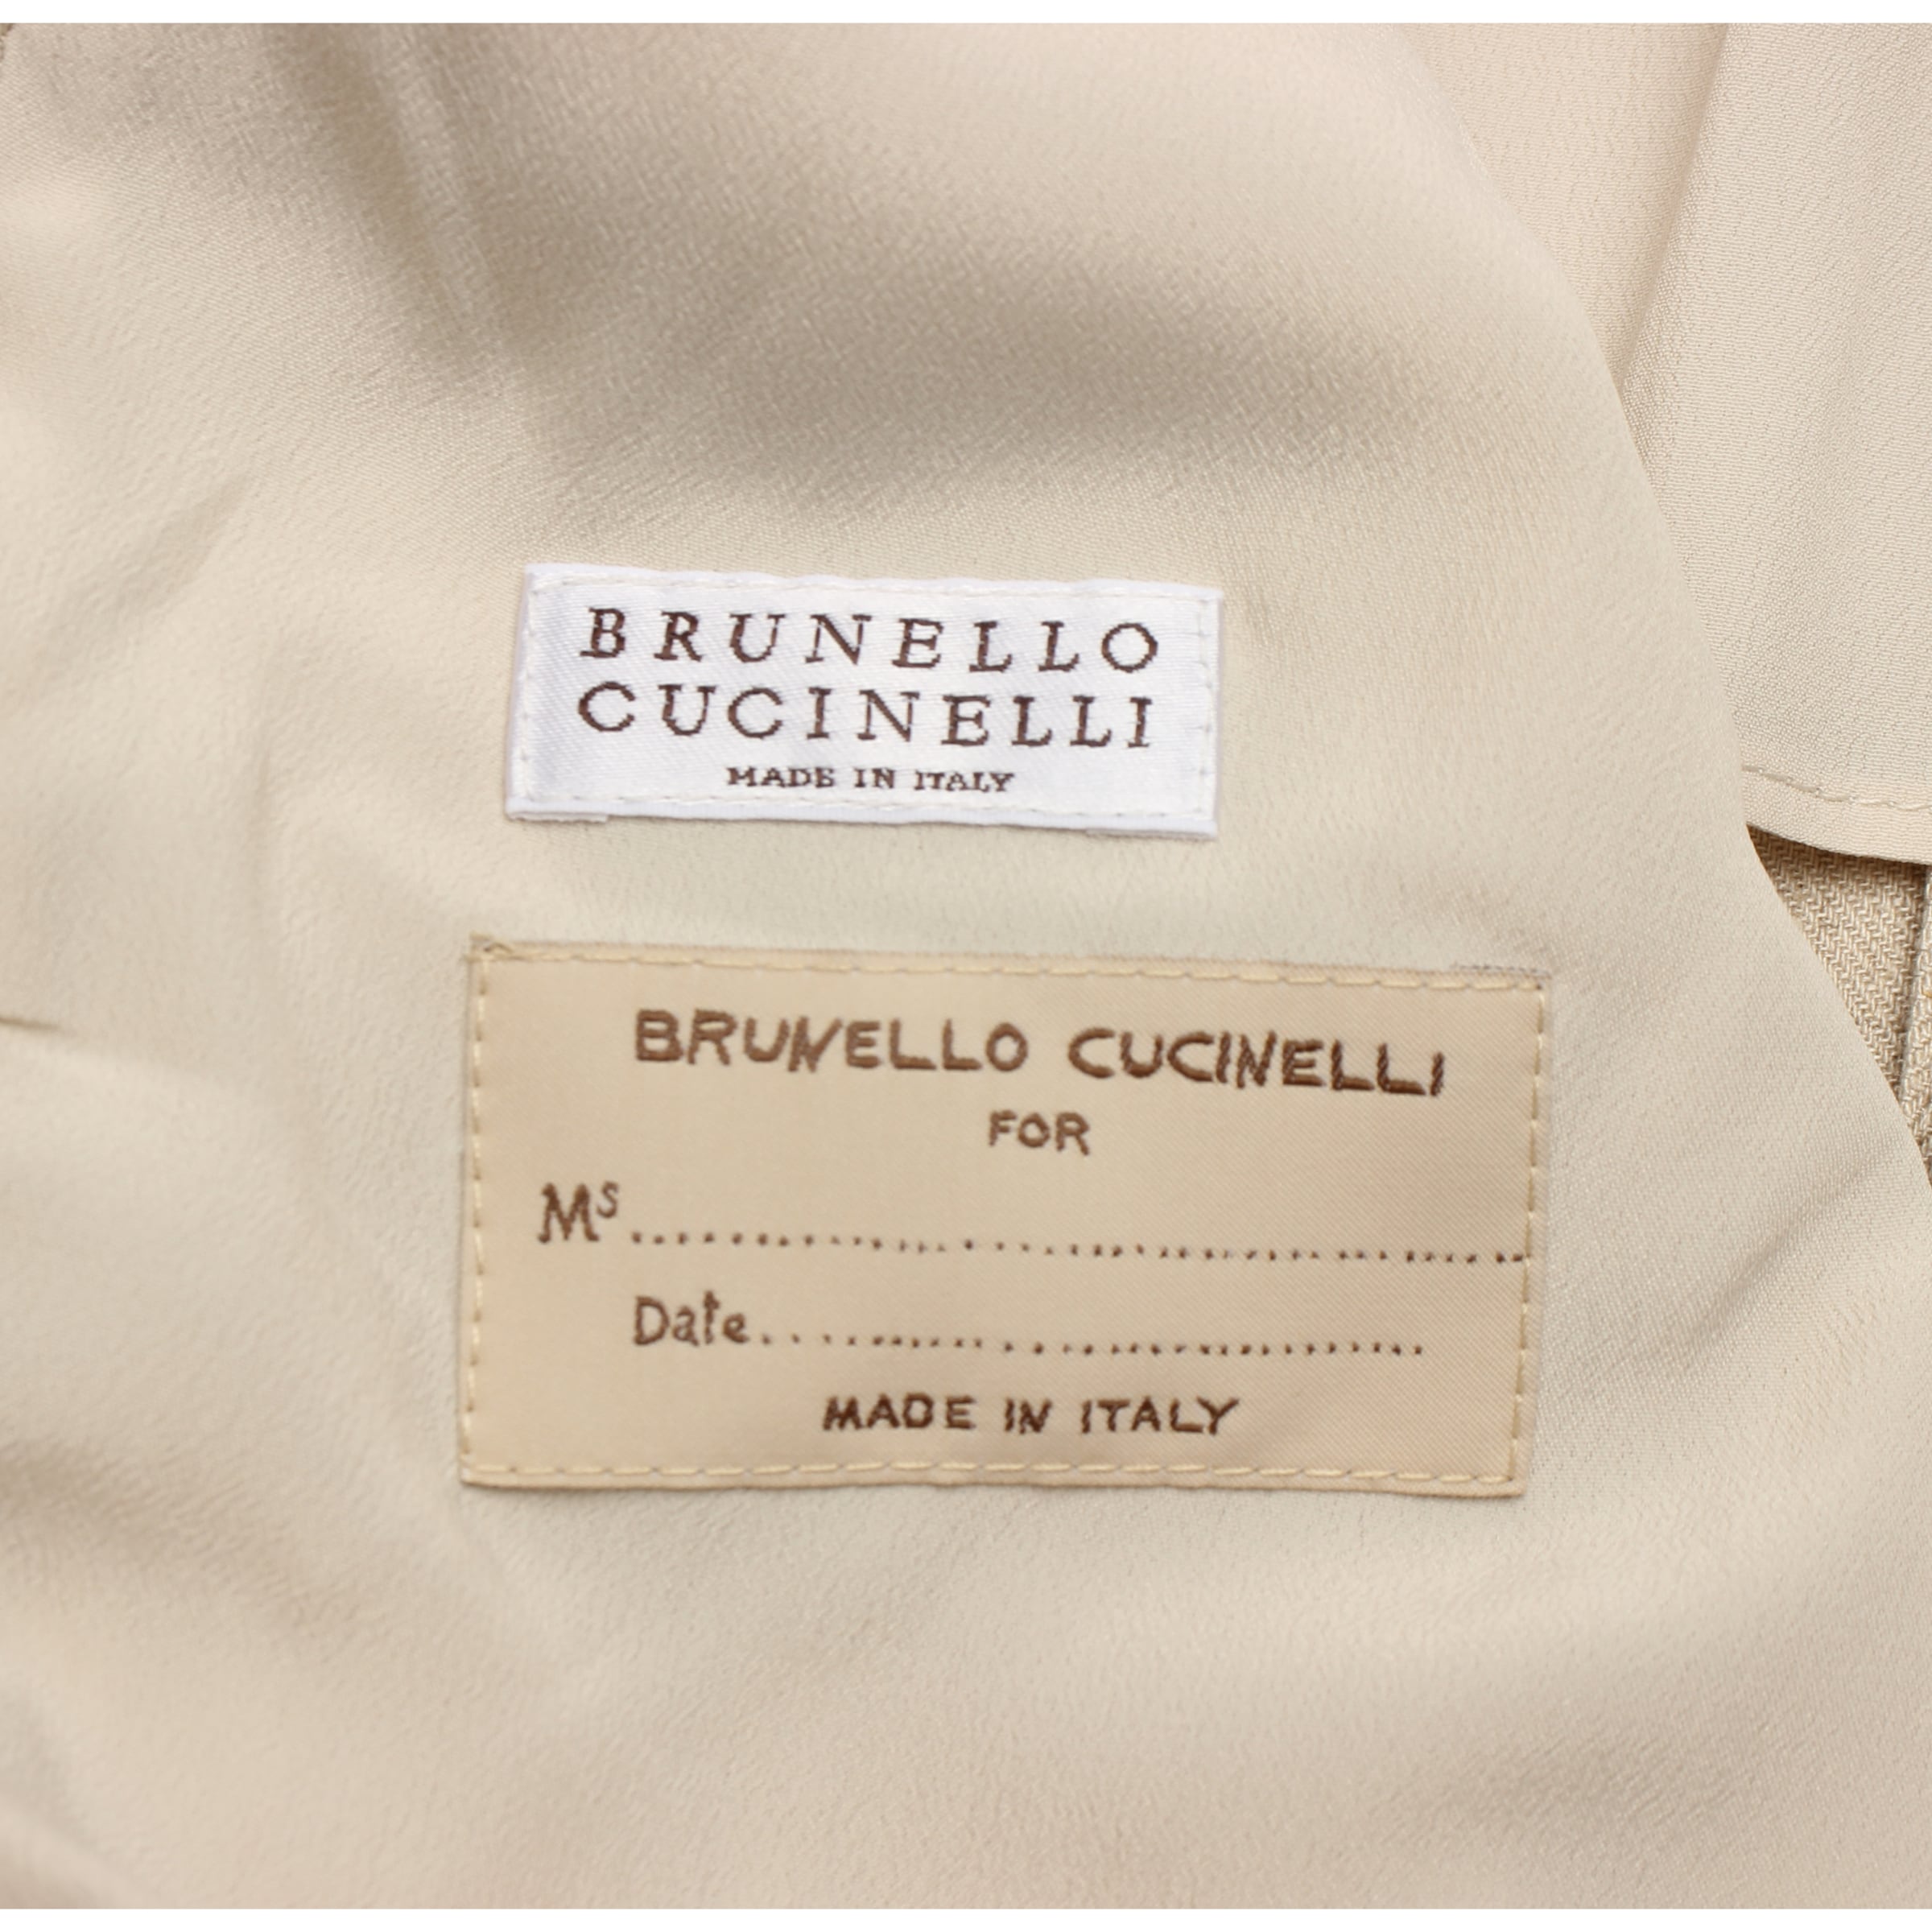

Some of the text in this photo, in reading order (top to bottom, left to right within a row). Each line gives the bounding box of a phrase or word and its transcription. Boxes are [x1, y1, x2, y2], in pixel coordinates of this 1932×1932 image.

[580, 606, 1159, 675] BRUNELLO
[577, 680, 1154, 749] CUCINELLI
[726, 766, 1017, 794] MADE IN ITALY
[634, 1009, 1446, 1098] BRUNELLO CUCINELLI
[989, 1109, 1091, 1156] FOR
[822, 1393, 1240, 1436] MADE IN ITALY
